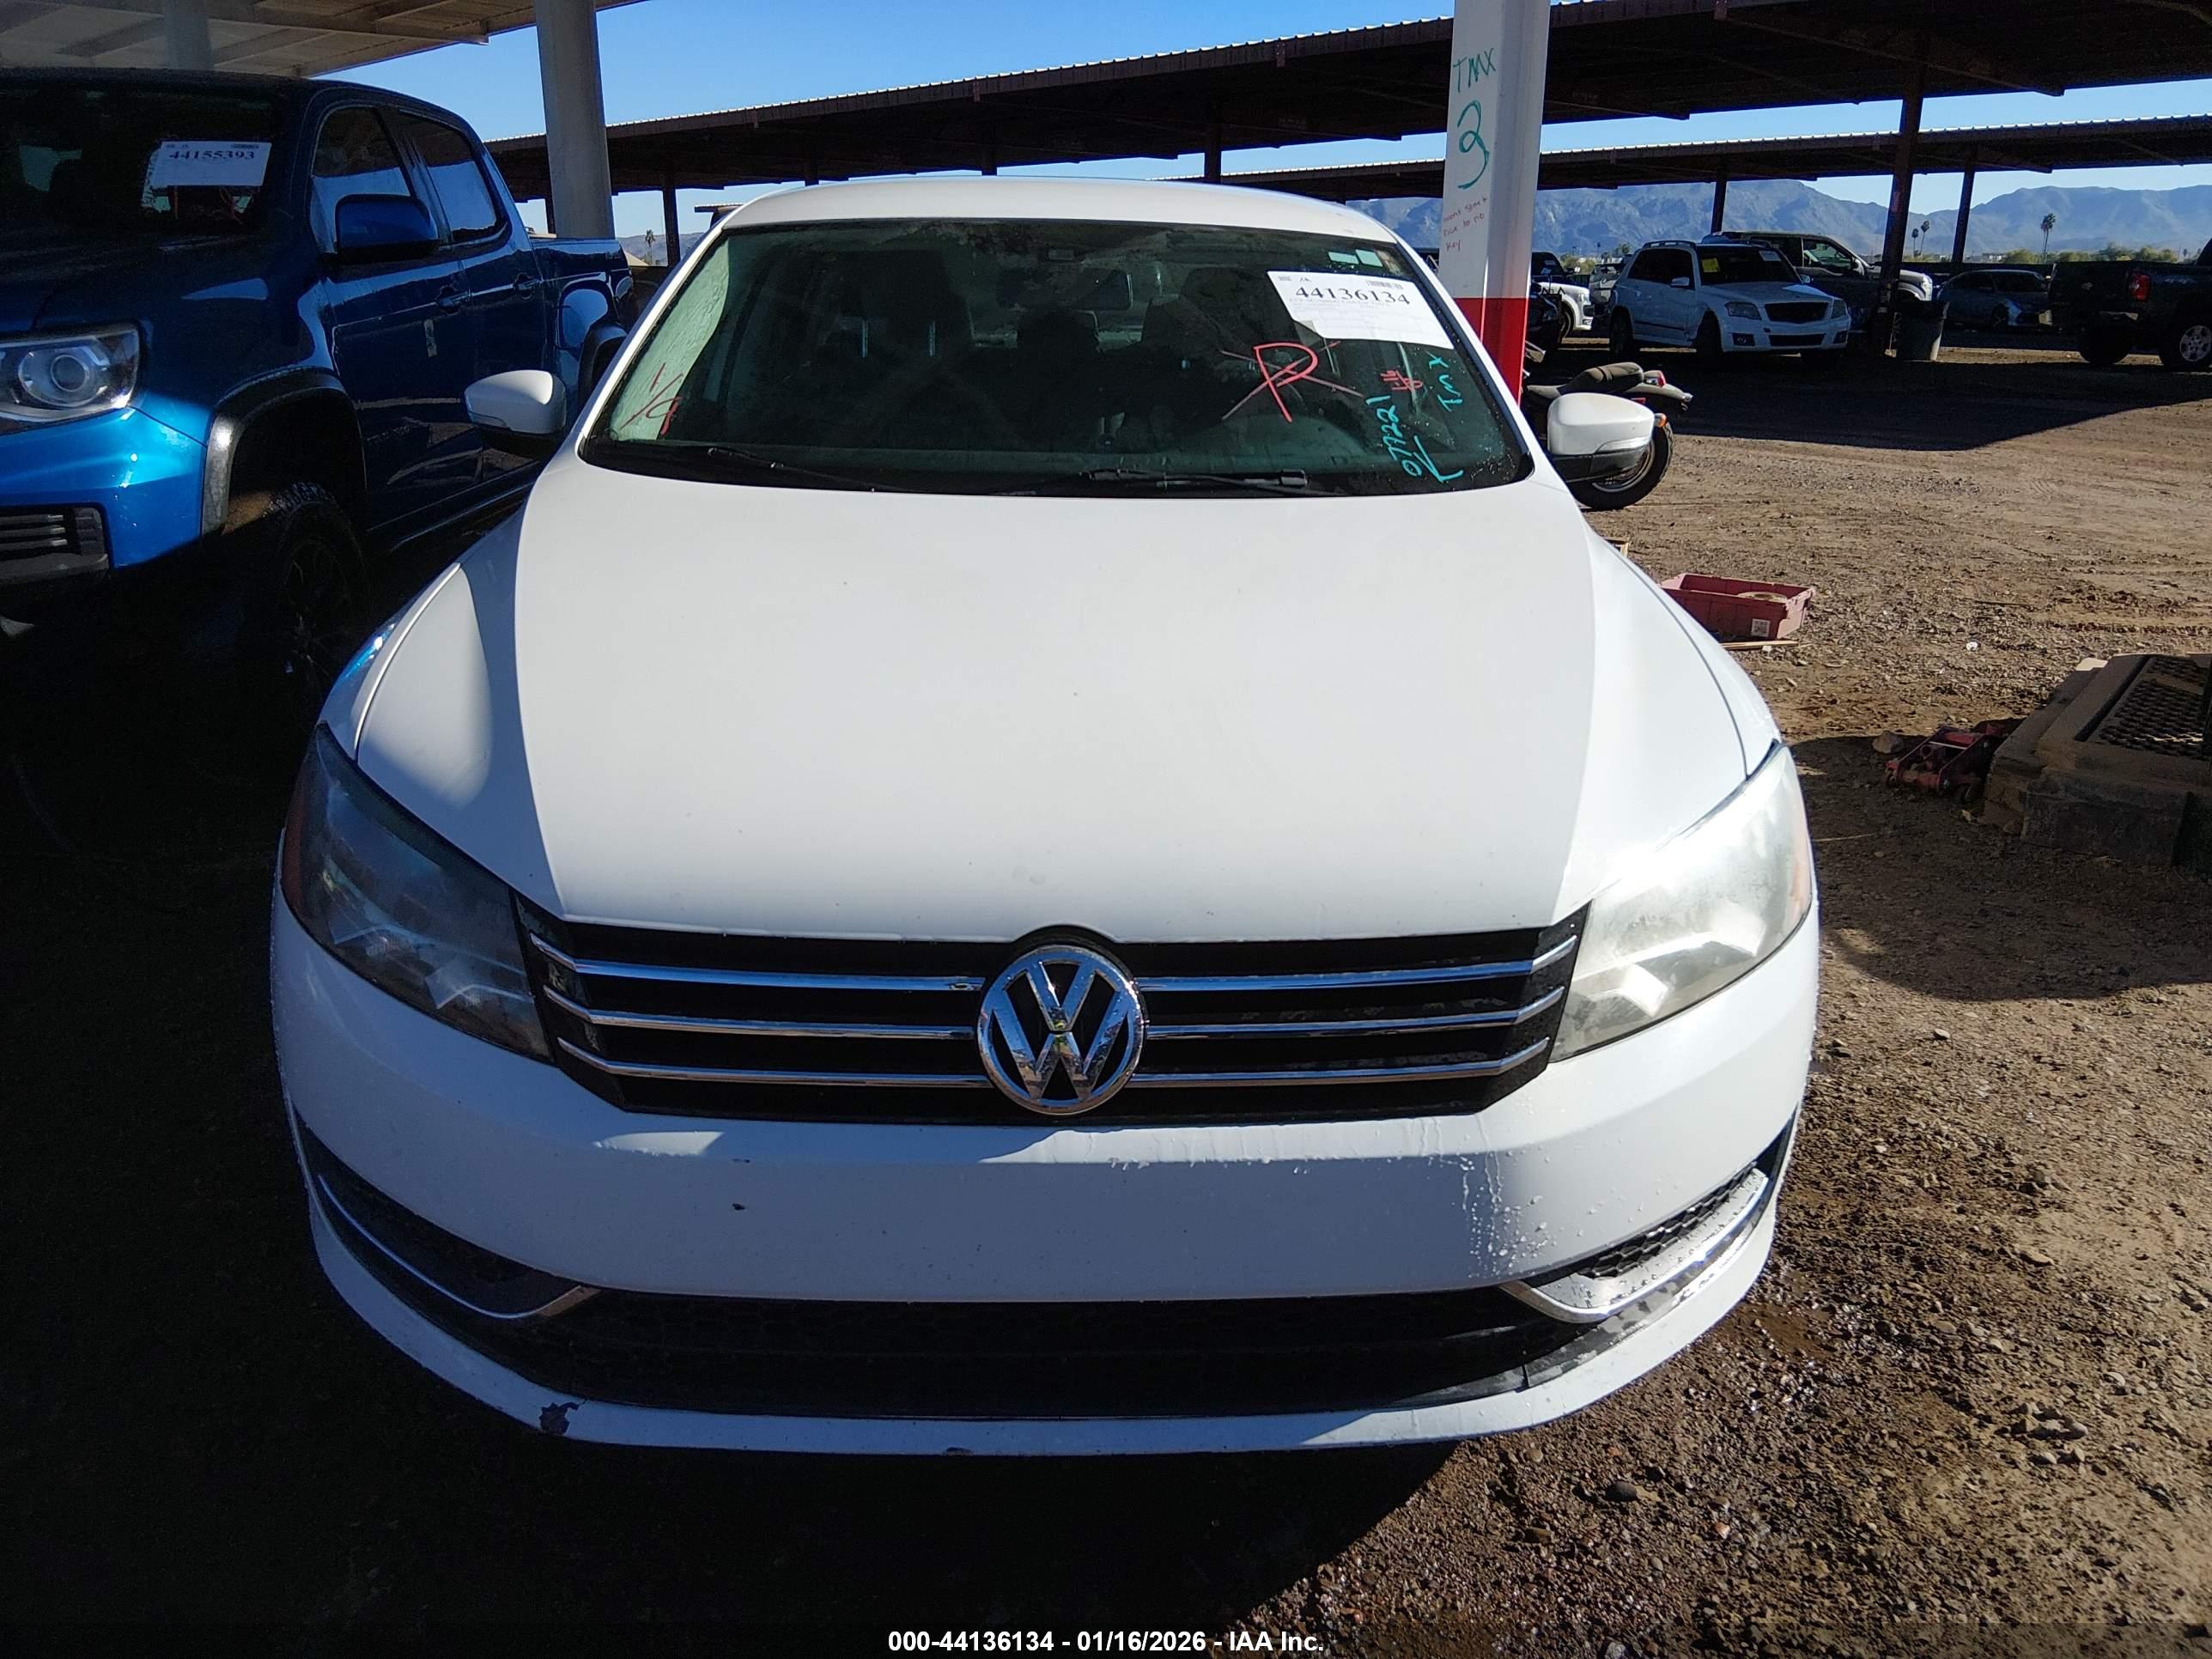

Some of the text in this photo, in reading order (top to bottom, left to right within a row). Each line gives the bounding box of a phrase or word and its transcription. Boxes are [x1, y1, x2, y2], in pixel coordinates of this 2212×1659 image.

[1453, 47, 1496, 93] TMX
[169, 150, 255, 160] 44155393
[1296, 287, 1410, 305] 44136134
